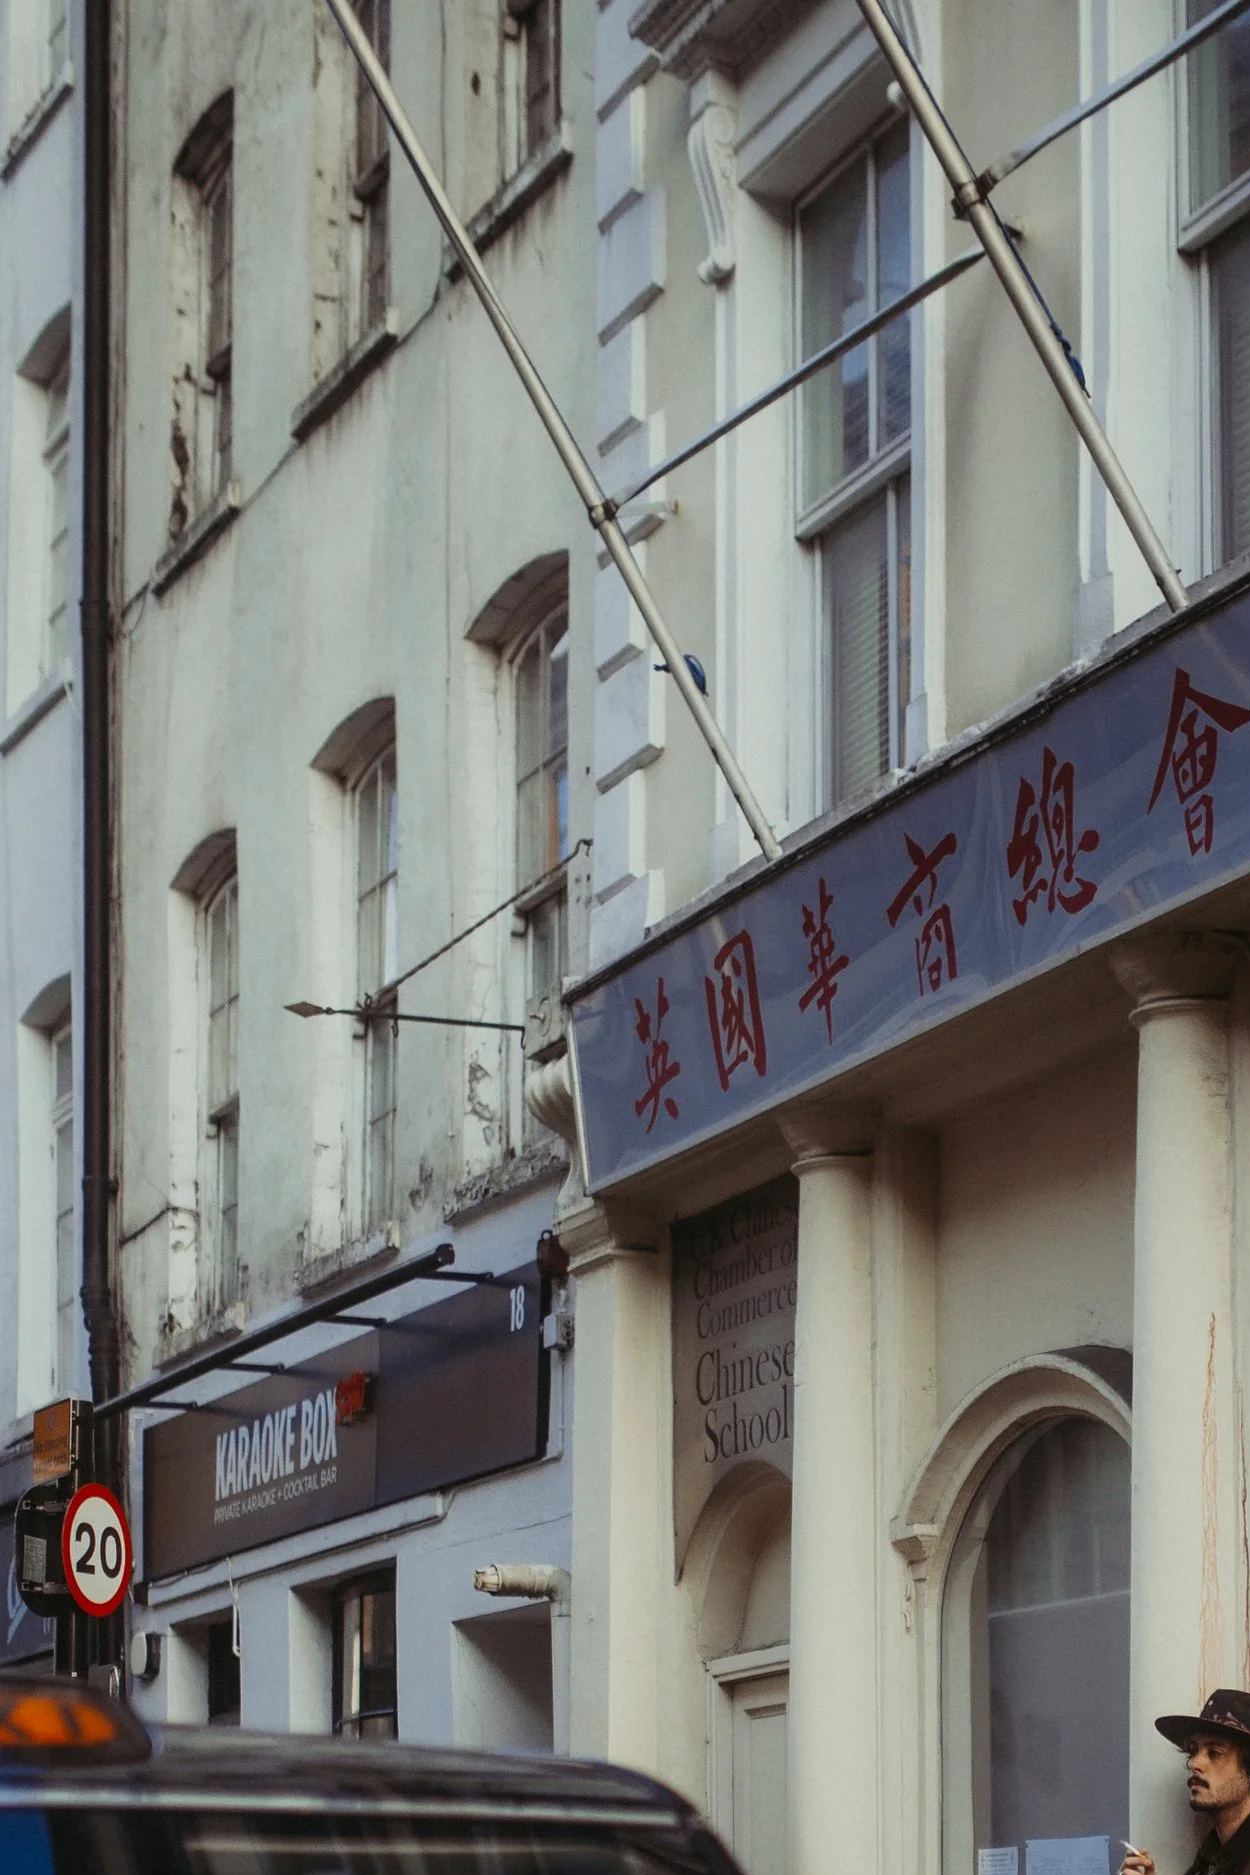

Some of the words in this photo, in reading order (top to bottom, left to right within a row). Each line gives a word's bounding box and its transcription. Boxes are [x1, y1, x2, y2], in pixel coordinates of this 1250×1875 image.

[694, 1247, 778, 1301] Chamber
[509, 1286, 525, 1332] 18
[696, 1278, 797, 1341] Commerce
[696, 1338, 794, 1407] Chinese
[215, 1404, 297, 1501] KARAOKE
[300, 1387, 337, 1470] BOX
[705, 1383, 790, 1464] School
[214, 1500, 241, 1526] PRIVATE
[241, 1487, 277, 1516] KARAOKE
[283, 1471, 320, 1501] COCKTAIL
[320, 1465, 338, 1488] BAR
[75, 1521, 122, 1579] 20
